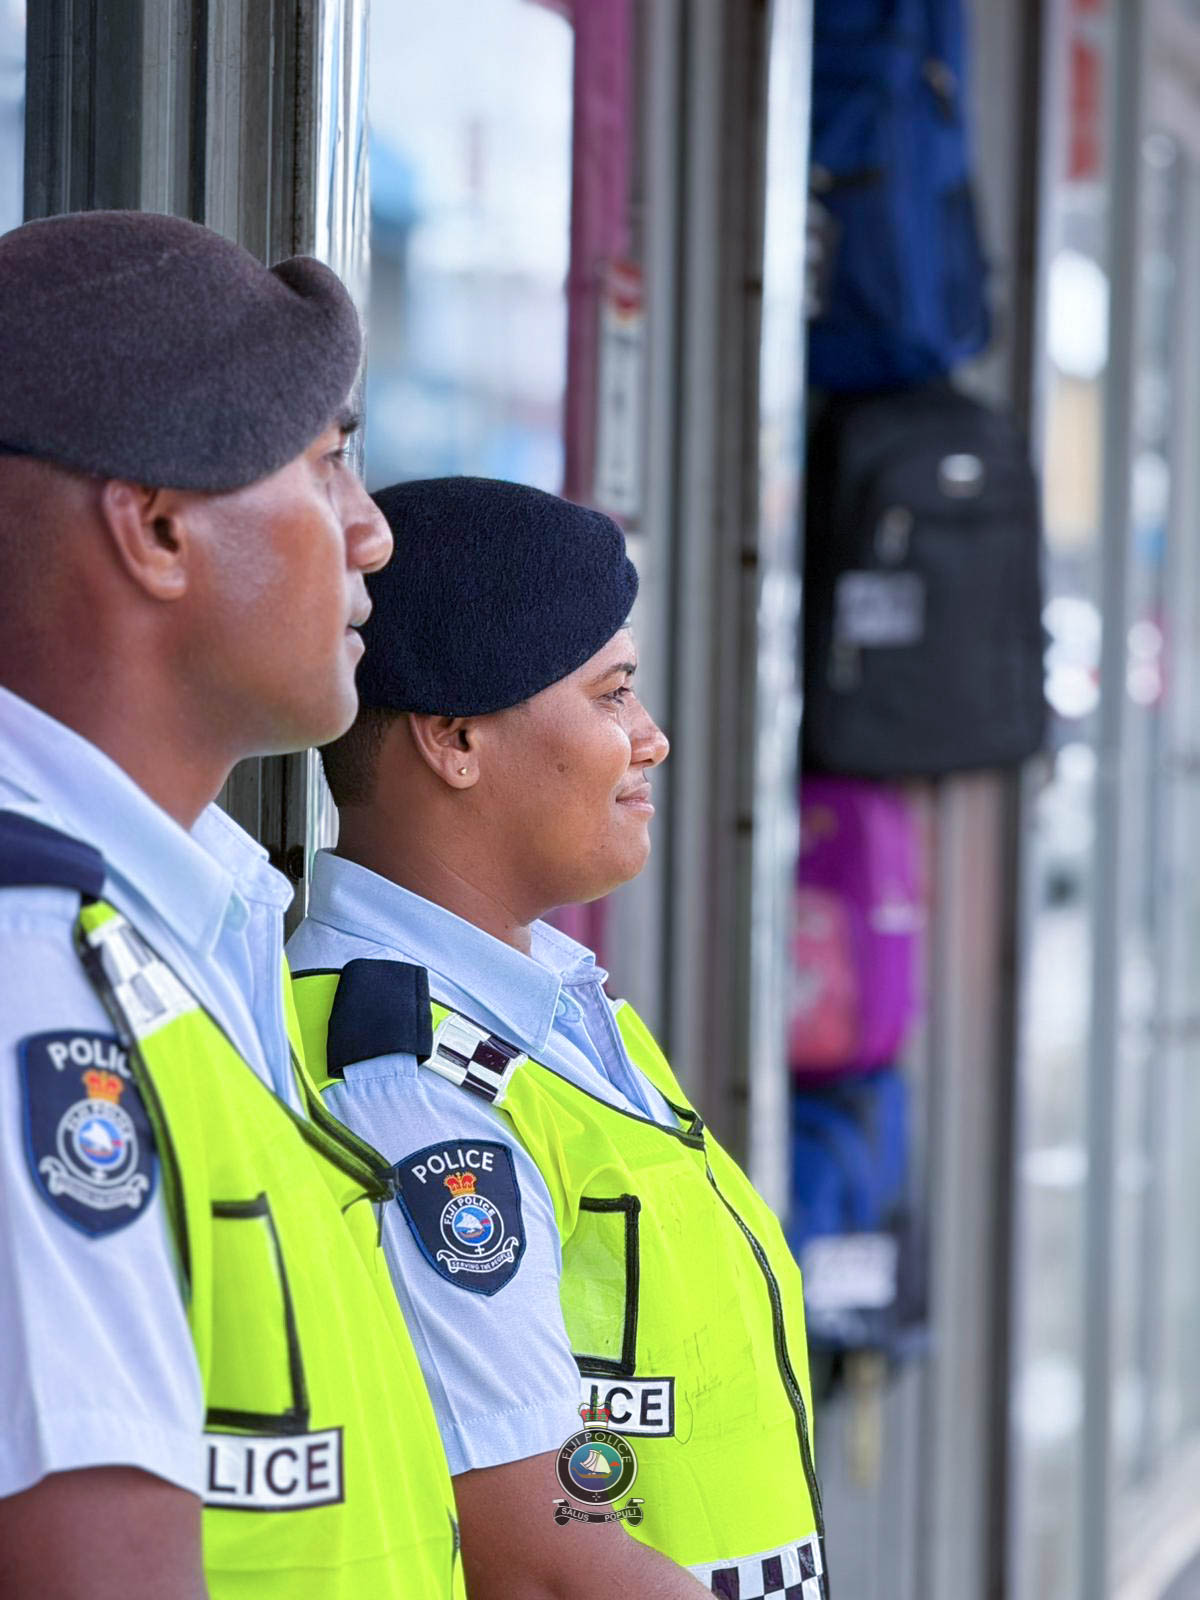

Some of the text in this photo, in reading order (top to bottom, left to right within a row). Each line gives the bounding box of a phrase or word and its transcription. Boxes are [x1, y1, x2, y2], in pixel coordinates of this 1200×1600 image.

[412, 1149, 494, 1184] POLICE
[444, 1196, 496, 1225] FIJI POLICE
[208, 1442, 329, 1495] LICE
